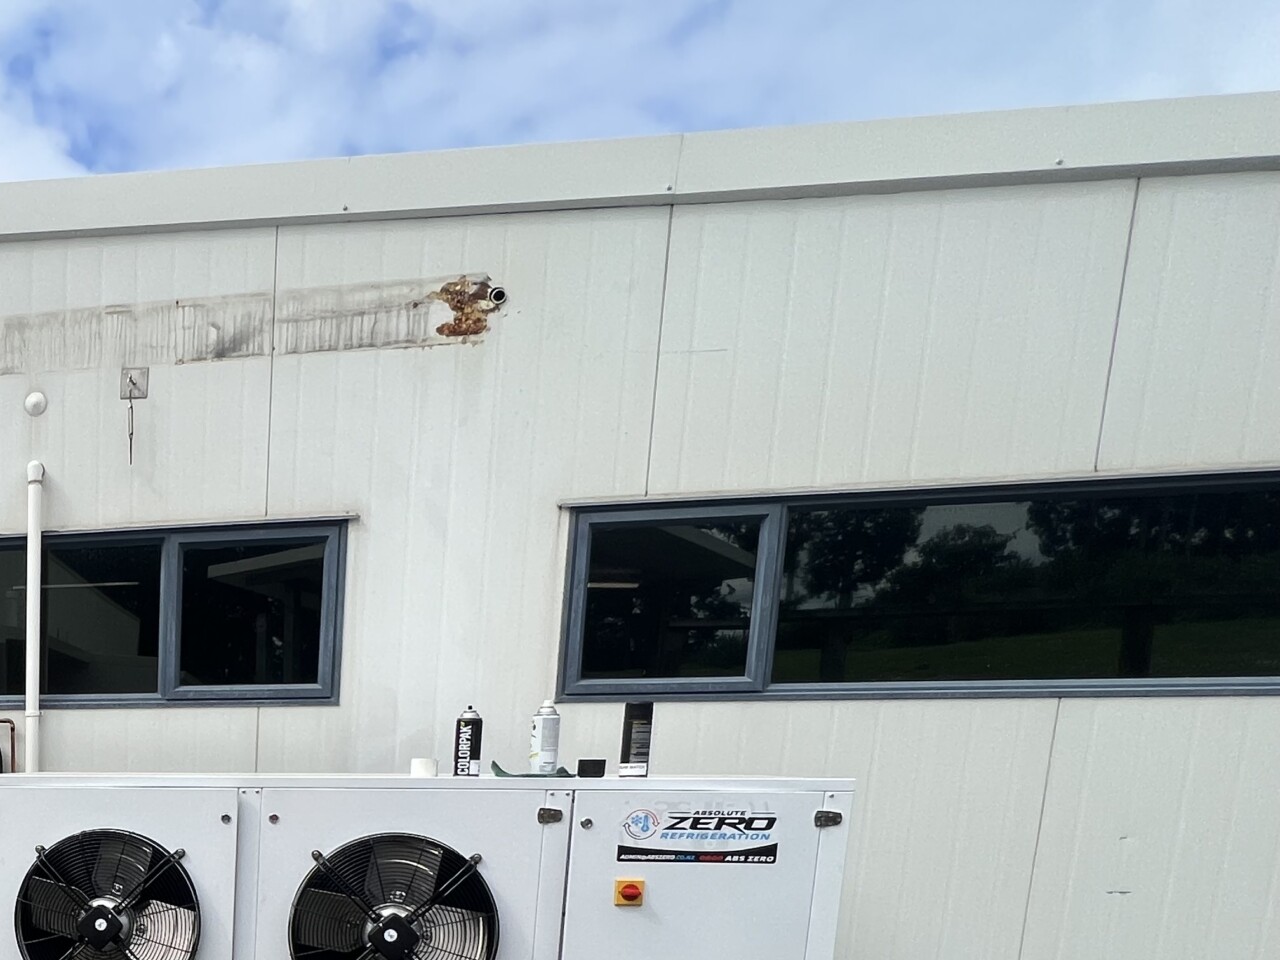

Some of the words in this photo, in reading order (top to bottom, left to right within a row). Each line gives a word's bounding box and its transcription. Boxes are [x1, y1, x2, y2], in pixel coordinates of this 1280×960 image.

[457, 725, 472, 776] COLORPAK
[662, 816, 778, 834] ZERO
[660, 832, 771, 841] REFRIGERATION
[747, 855, 775, 863] ZERO
